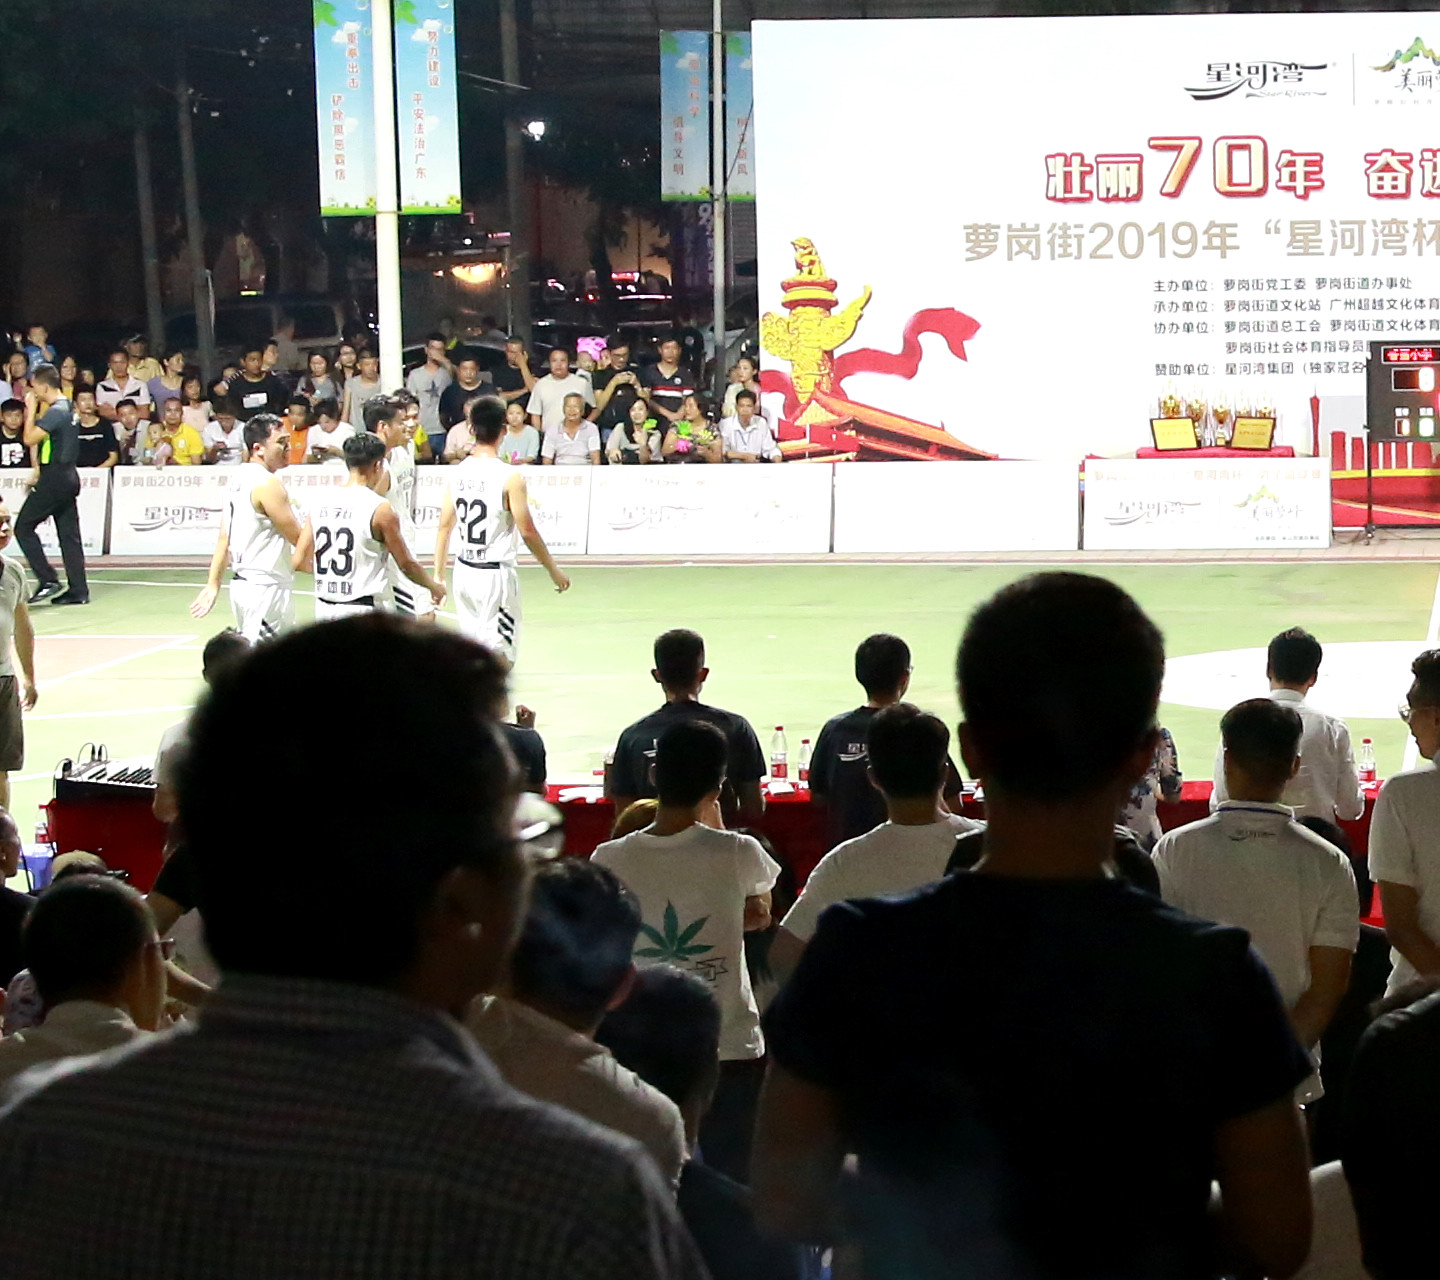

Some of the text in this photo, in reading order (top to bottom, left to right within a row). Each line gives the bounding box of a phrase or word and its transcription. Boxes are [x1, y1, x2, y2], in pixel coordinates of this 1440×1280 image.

[426, 31, 441, 88] 努力建设
[1206, 62, 1304, 90] 星河湾
[412, 92, 427, 180] 平安法治广东
[1045, 135, 1326, 204] 壮丽70年
[1225, 340, 1370, 354] 萝岗街社会体育指导员
[315, 525, 354, 577] 23
